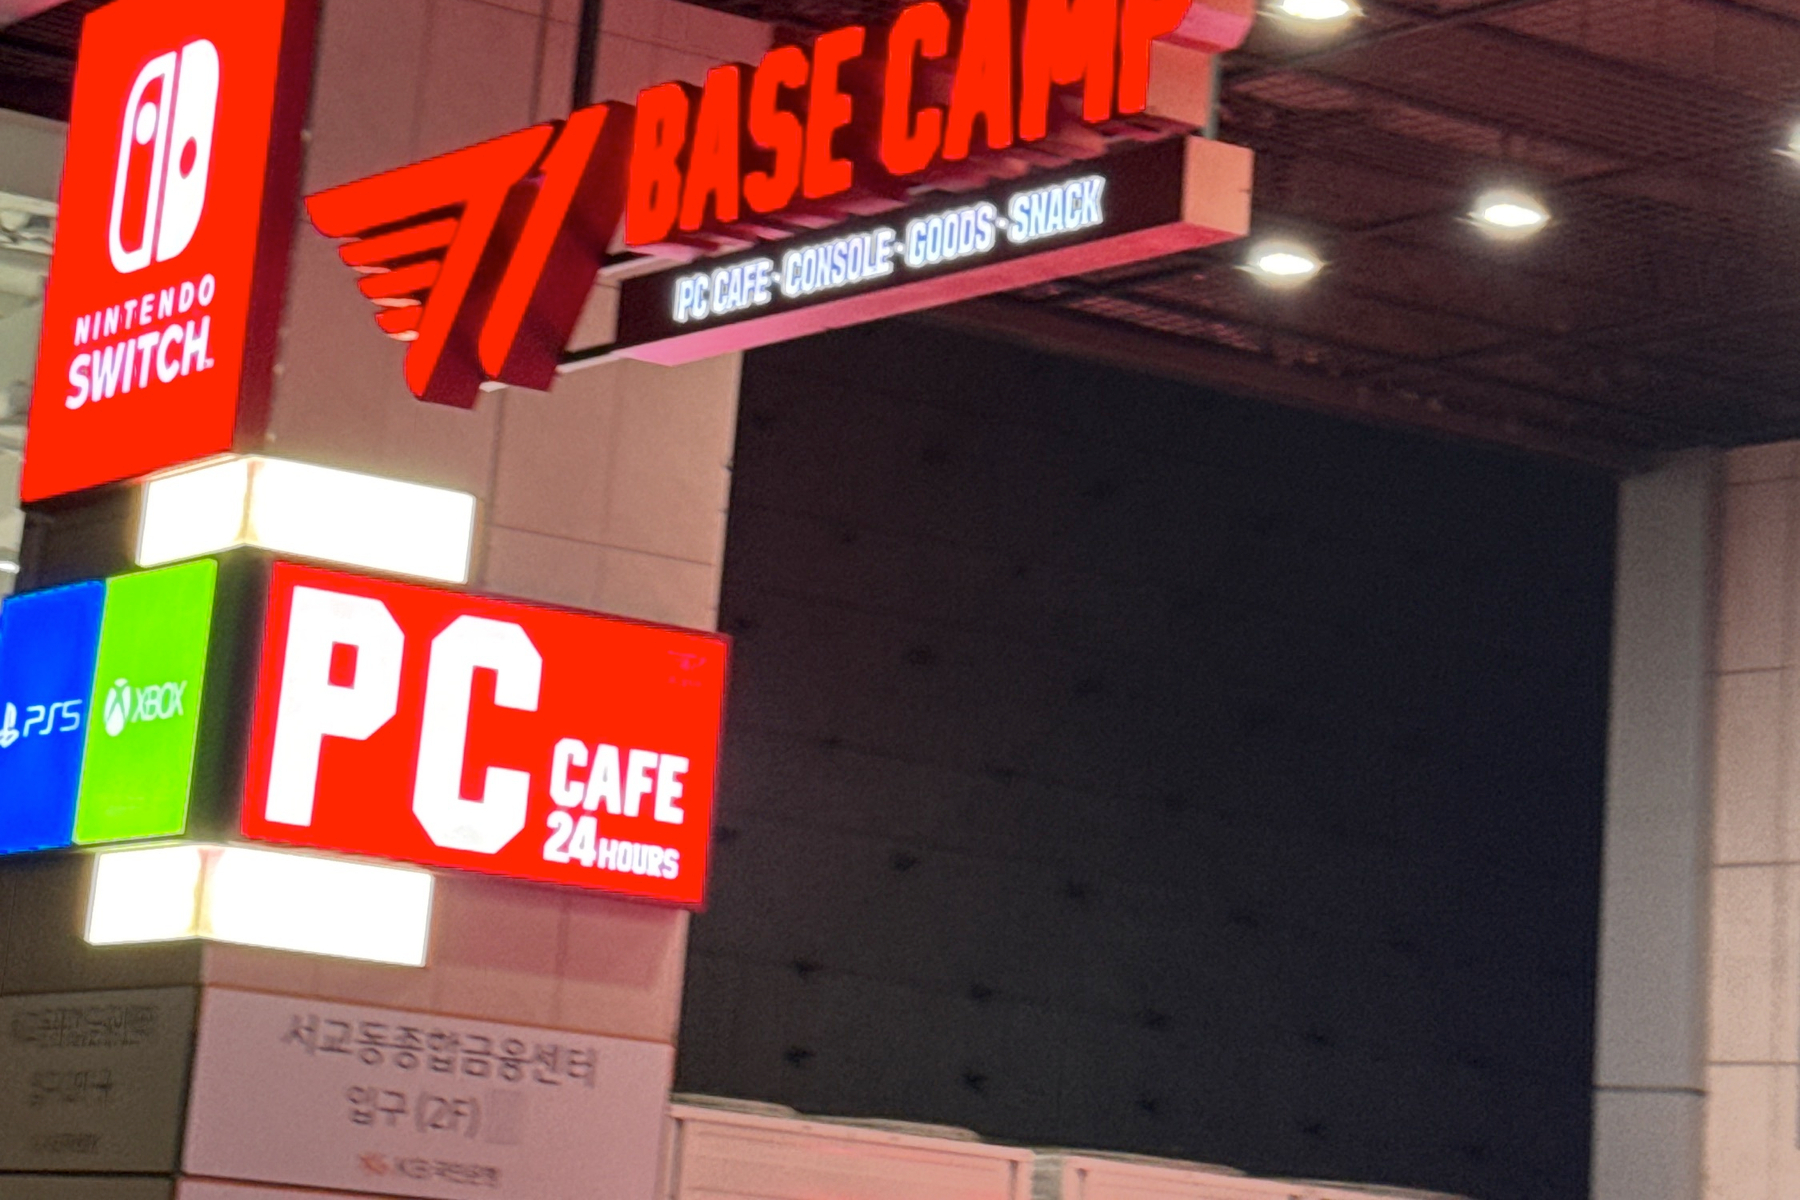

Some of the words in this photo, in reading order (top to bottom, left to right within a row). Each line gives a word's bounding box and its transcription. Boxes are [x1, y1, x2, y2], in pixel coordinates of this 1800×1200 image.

[625, 26, 866, 246] BASE
[674, 274, 709, 322] PC
[711, 259, 773, 315] CAFE
[782, 228, 896, 295] CONSOLE
[905, 202, 996, 268] GOODS
[1007, 176, 1105, 242] SNACK
[74, 273, 216, 346] NINTENDO
[64, 315, 210, 411] SWITCH
[22, 698, 82, 738] PS5
[131, 680, 188, 723] XBOX
[264, 585, 543, 854] PC
[549, 738, 689, 824] CAFE
[281, 1012, 598, 1088] 서교동종합금융센터
